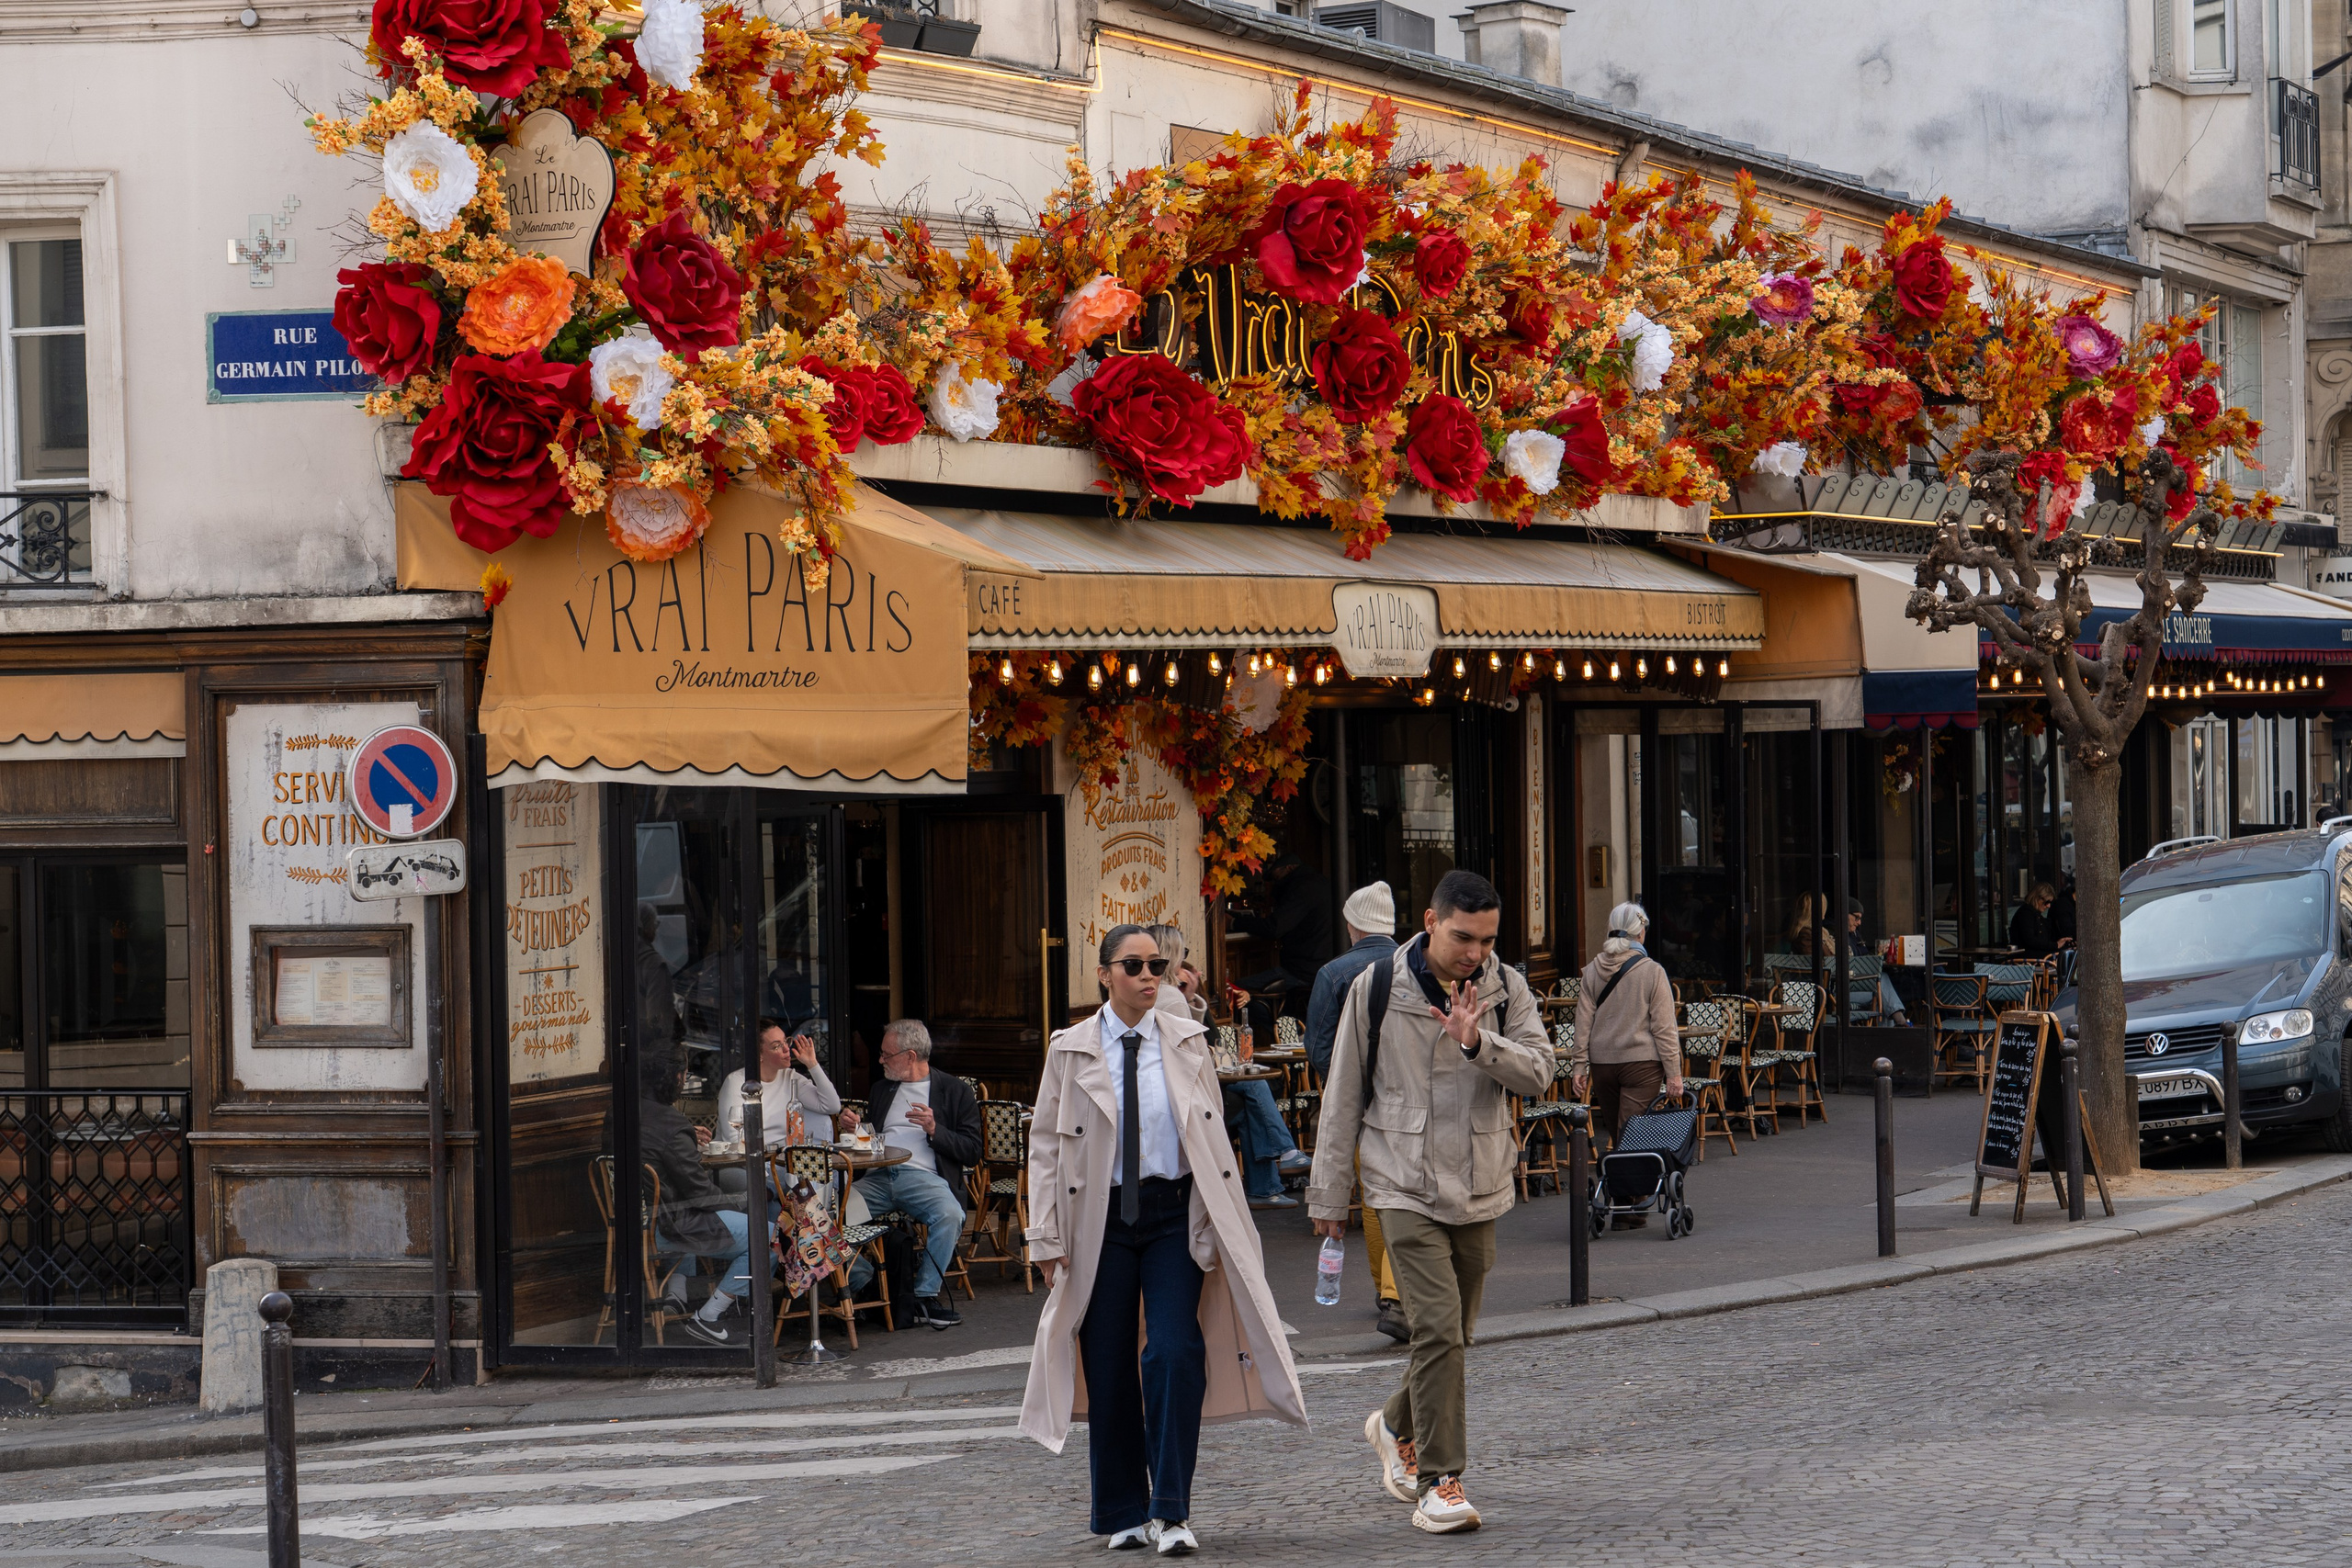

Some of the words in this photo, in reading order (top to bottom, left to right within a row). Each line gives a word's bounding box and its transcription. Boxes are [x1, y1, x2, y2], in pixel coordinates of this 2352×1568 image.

[535, 144, 555, 164] Le
[504, 172, 538, 216] RAI
[548, 171, 595, 212] PARIS
[515, 220, 576, 236] Montmartre
[274, 328, 317, 344] RUE
[216, 361, 306, 378] GERMAIN
[315, 359, 364, 376] PILO
[562, 534, 710, 653] VRAI
[743, 531, 912, 653] PARIS
[978, 580, 1021, 615] CAFÉ
[1347, 593, 1384, 649] VRAI
[1387, 592, 1426, 651] PARIS
[1687, 604, 1725, 625] BISTROT
[2162, 617, 2171, 643] LE
[2173, 616, 2212, 644] SANCERRE
[655, 660, 820, 692] Montmartre
[1370, 652, 1407, 668] Montmartre
[1125, 757, 1140, 784] 18
[273, 772, 345, 804] SERVI
[510, 782, 579, 822] fruits
[524, 806, 567, 828] FRAIS
[1084, 784, 1181, 831] Restauration
[1532, 728, 1541, 911] BIENVENUE
[1101, 845, 1142, 880] PRODUITS
[1143, 846, 1167, 874] FRAIS
[519, 864, 573, 898] PETITS
[1131, 871, 1139, 893] &
[1102, 892, 1126, 924] FAIT
[1127, 887, 1167, 924] MAISON
[510, 1007, 591, 1043] gourmands
[2142, 1119, 2189, 1130] ADDY
